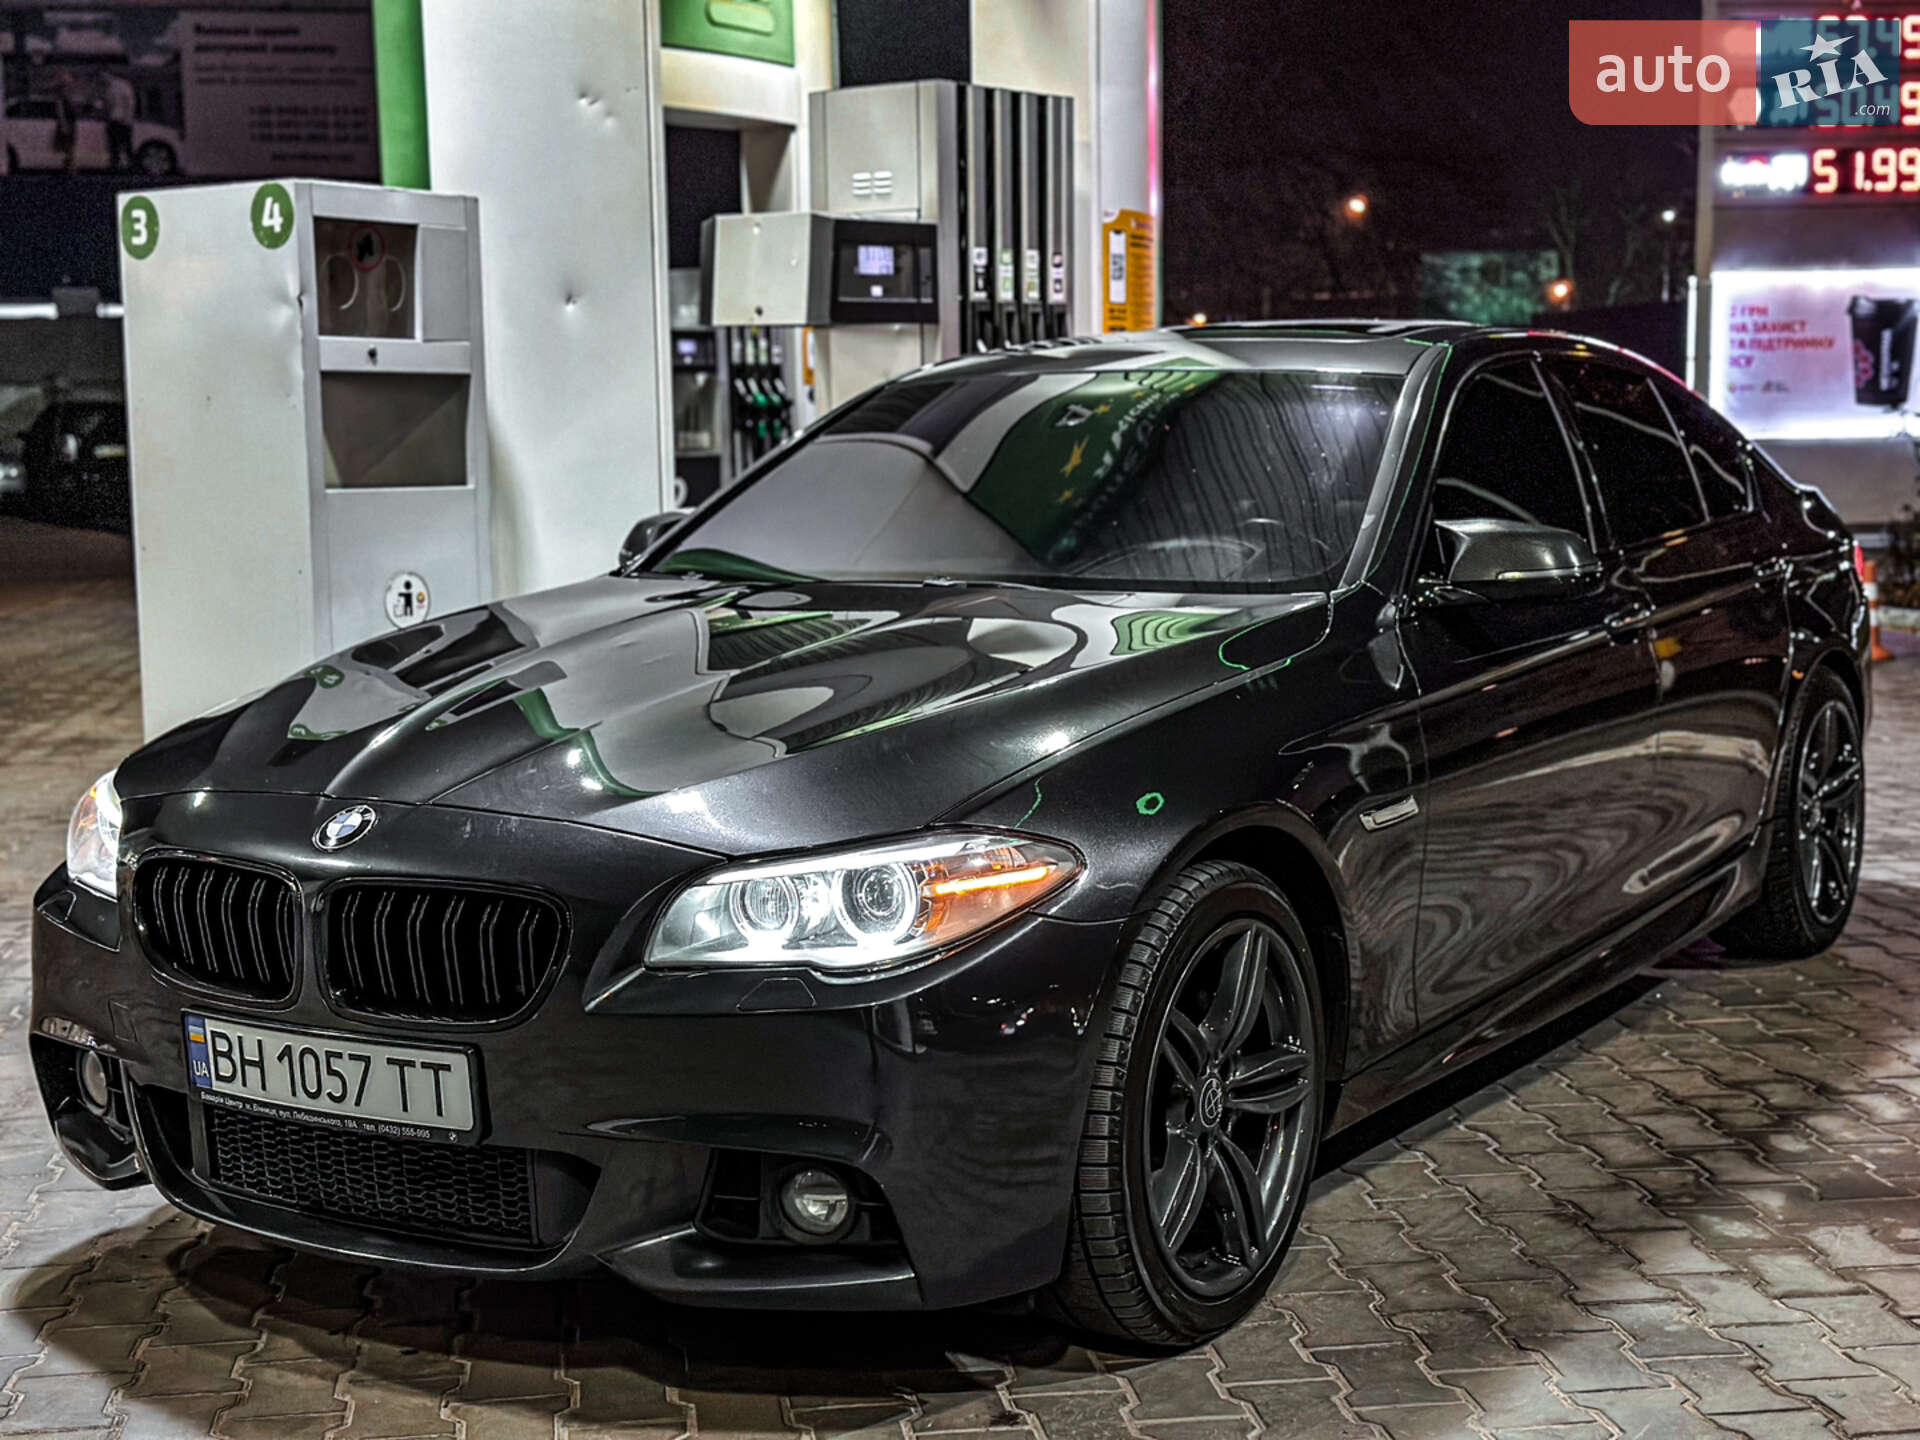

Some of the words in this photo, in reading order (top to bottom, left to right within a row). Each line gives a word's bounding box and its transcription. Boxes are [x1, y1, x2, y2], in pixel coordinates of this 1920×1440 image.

[131, 209, 148, 246] 3
[262, 197, 283, 233] 4
[193, 1060, 209, 1078] UA
[210, 1029, 267, 1092] BH
[276, 1043, 372, 1107] 1057
[386, 1056, 452, 1118] TT
